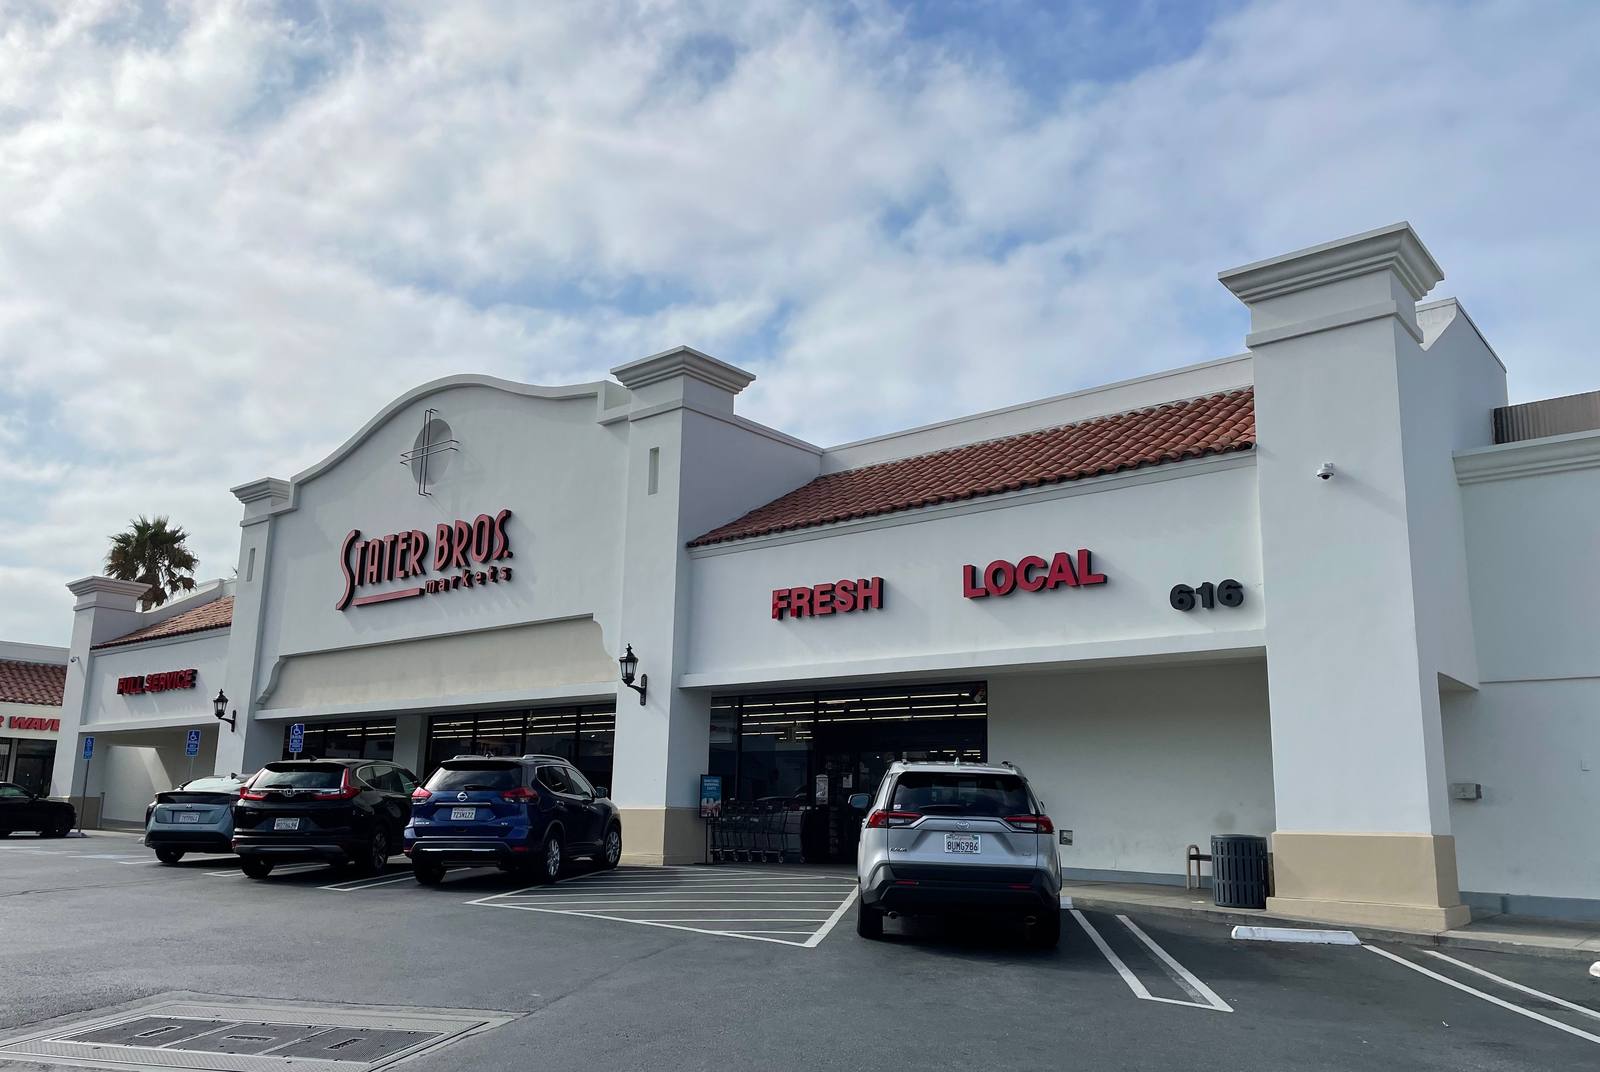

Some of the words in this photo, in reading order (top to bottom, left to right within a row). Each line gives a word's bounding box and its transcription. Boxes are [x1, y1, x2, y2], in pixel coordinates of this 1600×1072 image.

[335, 529, 429, 612] STATER
[424, 565, 513, 595] markets
[962, 548, 1108, 600] LOCAL
[771, 576, 884, 620] FRESH
[1169, 578, 1244, 612] 616
[117, 675, 146, 696] FULL
[145, 668, 198, 693] SERVICE
[946, 841, 979, 851] 8UMG986
